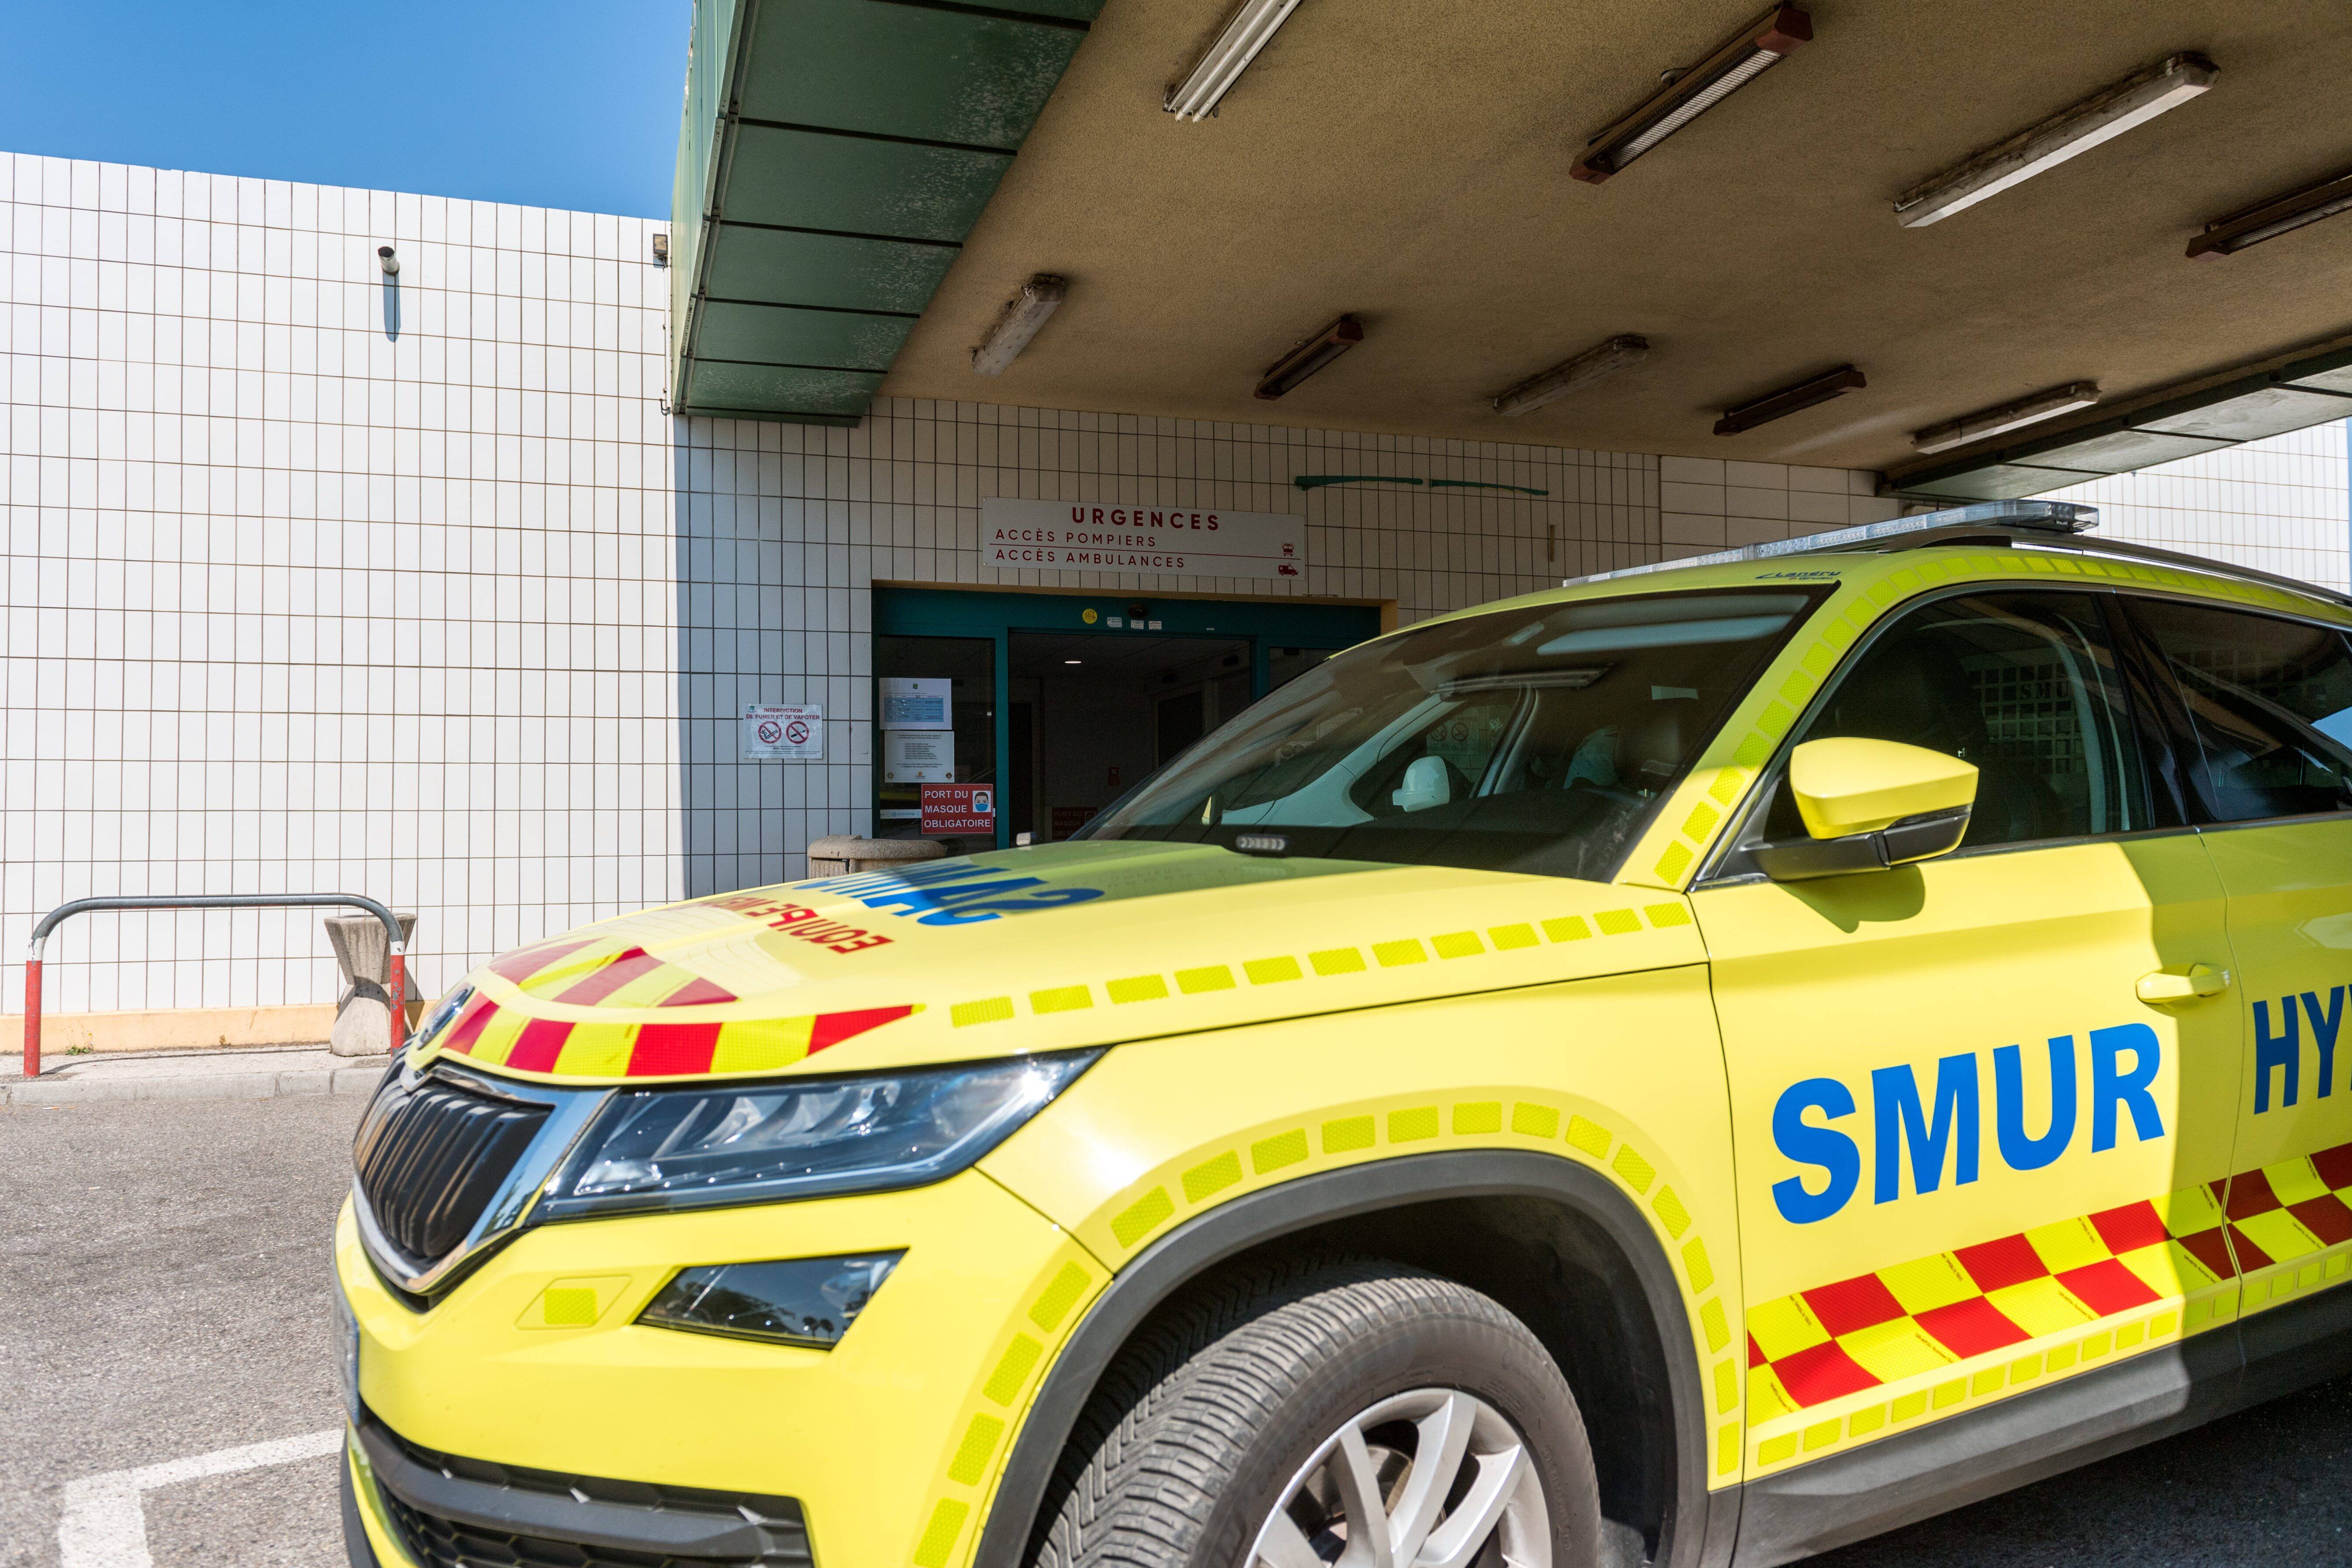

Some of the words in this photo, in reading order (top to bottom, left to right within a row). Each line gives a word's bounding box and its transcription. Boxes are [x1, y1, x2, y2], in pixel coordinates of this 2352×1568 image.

[1071, 507, 1220, 531] URGENCES
[995, 528, 1055, 542] ACCÈS
[1066, 532, 1156, 547] POMPIERS
[995, 549, 1055, 562] ACCÈS
[1066, 552, 1185, 568] AMBULANCES
[924, 805, 967, 813] MASQUE
[924, 819, 991, 828] OBLIGATOIRE
[2252, 984, 2352, 1115] HY
[1772, 1022, 2165, 1224] SMUR
